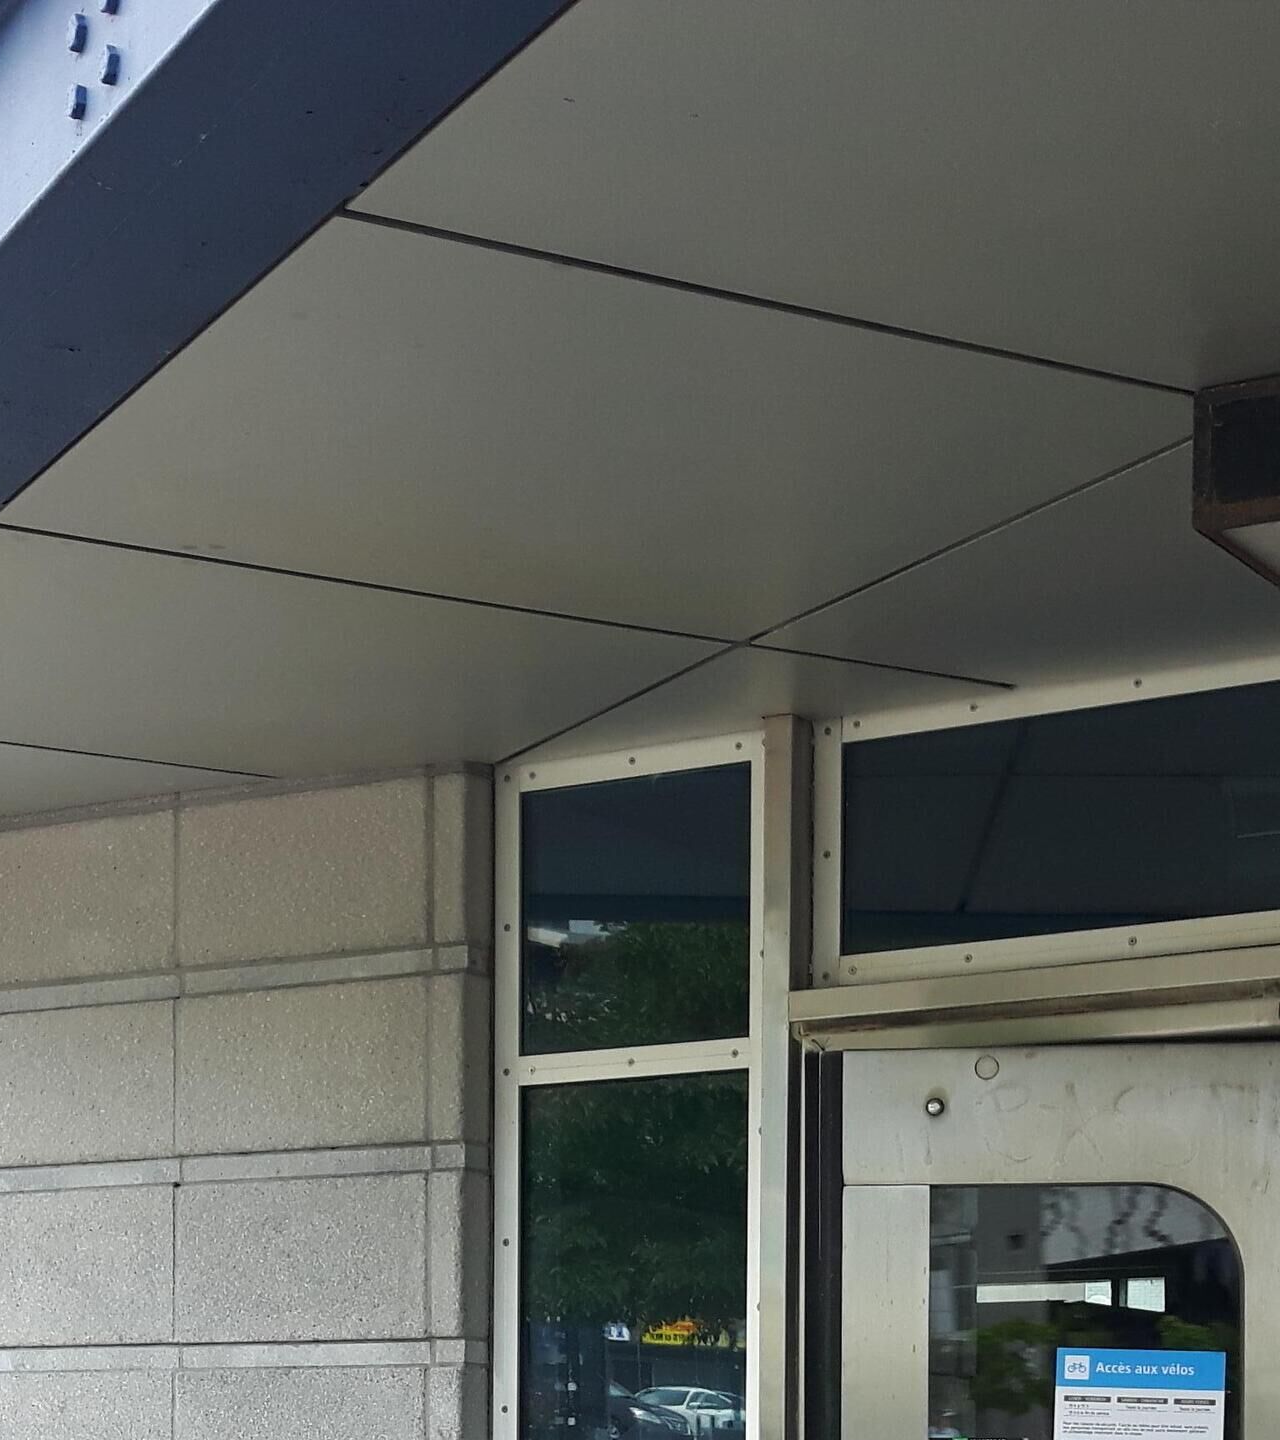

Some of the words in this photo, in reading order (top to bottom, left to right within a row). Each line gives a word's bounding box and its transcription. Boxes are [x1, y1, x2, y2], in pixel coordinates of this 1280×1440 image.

[1095, 1361, 1132, 1374] Accès
[1135, 1363, 1159, 1375] aux
[1161, 1363, 1195, 1376] vélos
